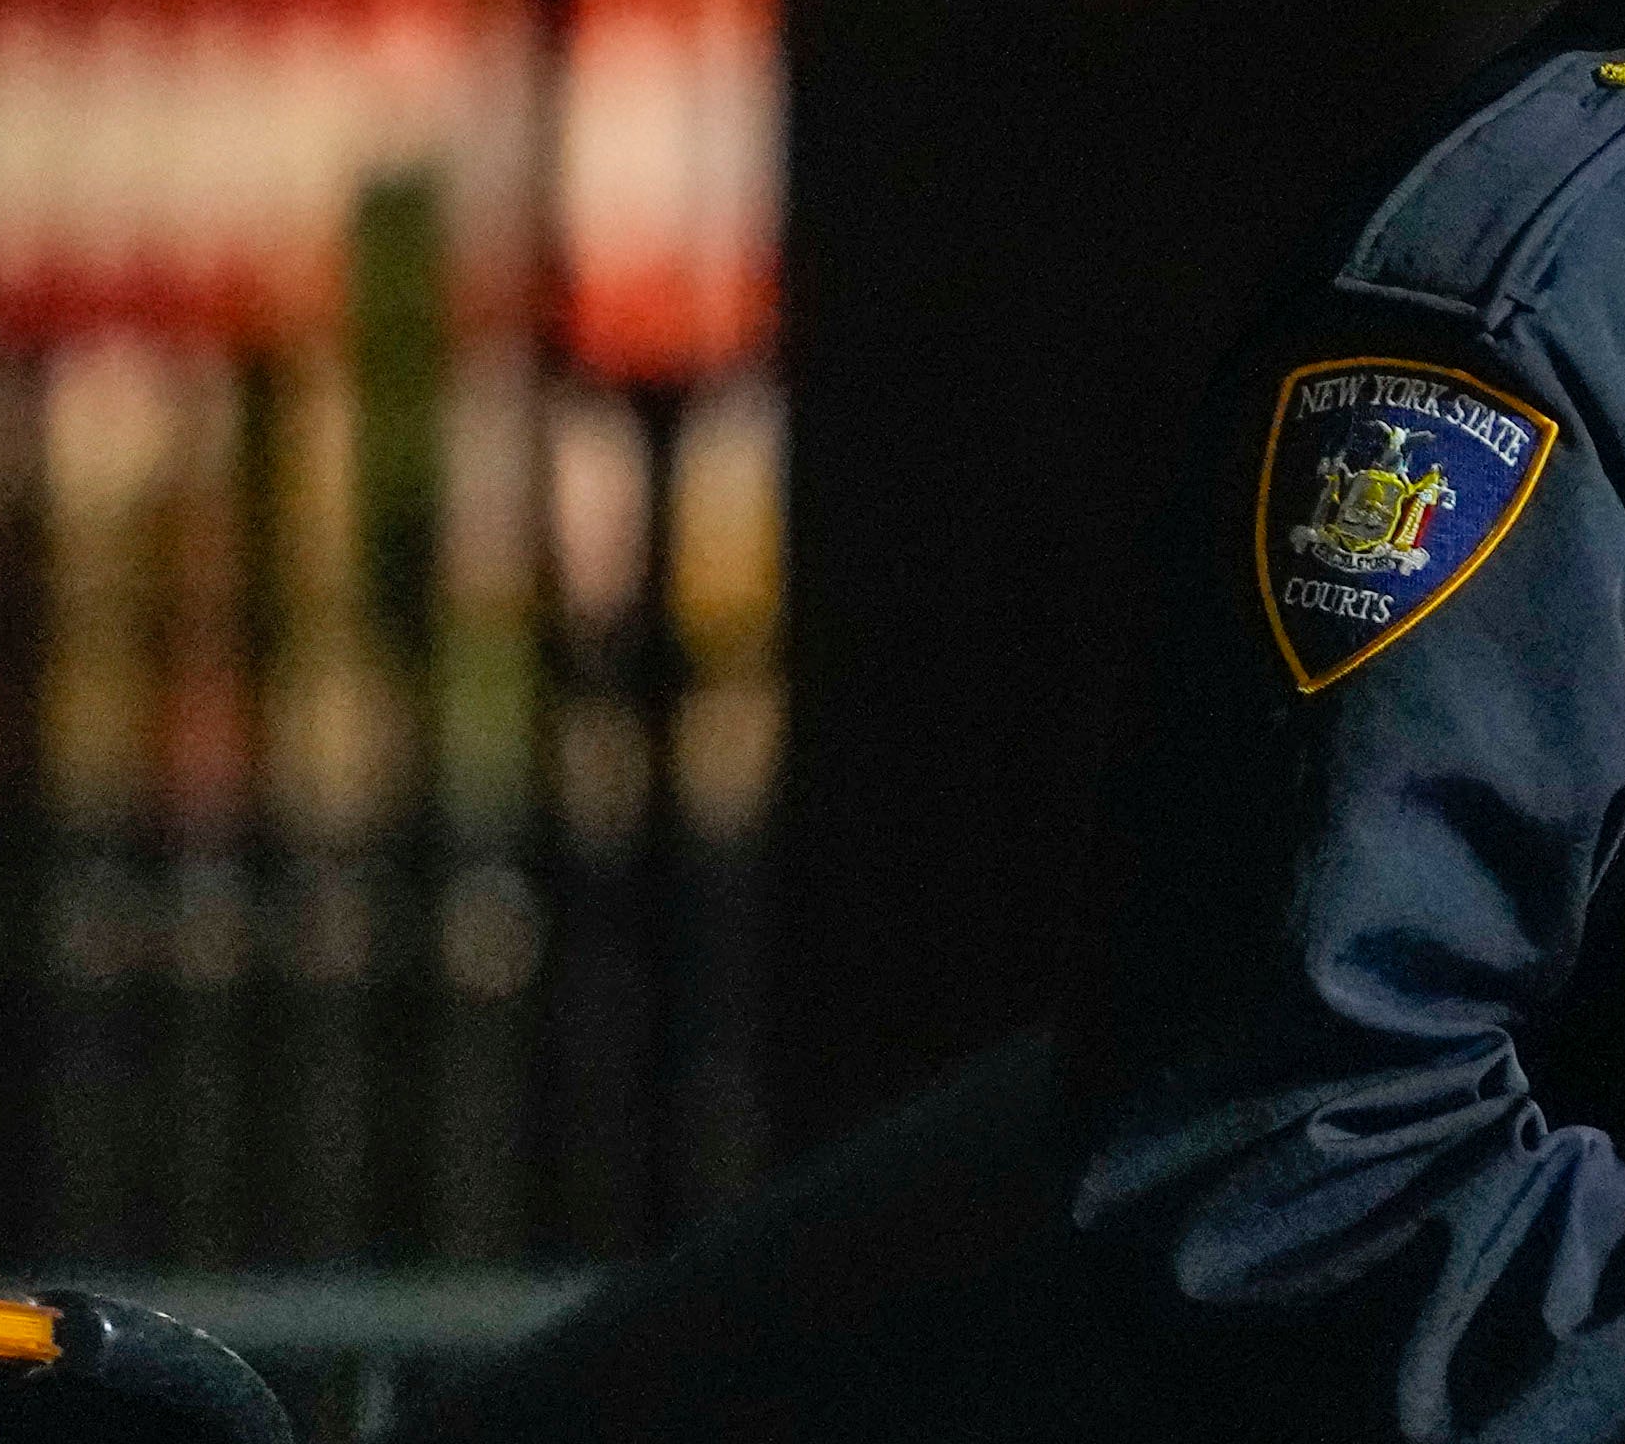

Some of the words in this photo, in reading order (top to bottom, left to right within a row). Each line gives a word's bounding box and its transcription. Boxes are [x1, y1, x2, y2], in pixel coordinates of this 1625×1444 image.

[1296, 375, 1366, 419] NEW
[1371, 374, 1449, 418] YORK
[1445, 394, 1530, 467] STATE
[1283, 577, 1395, 624] COURTS
